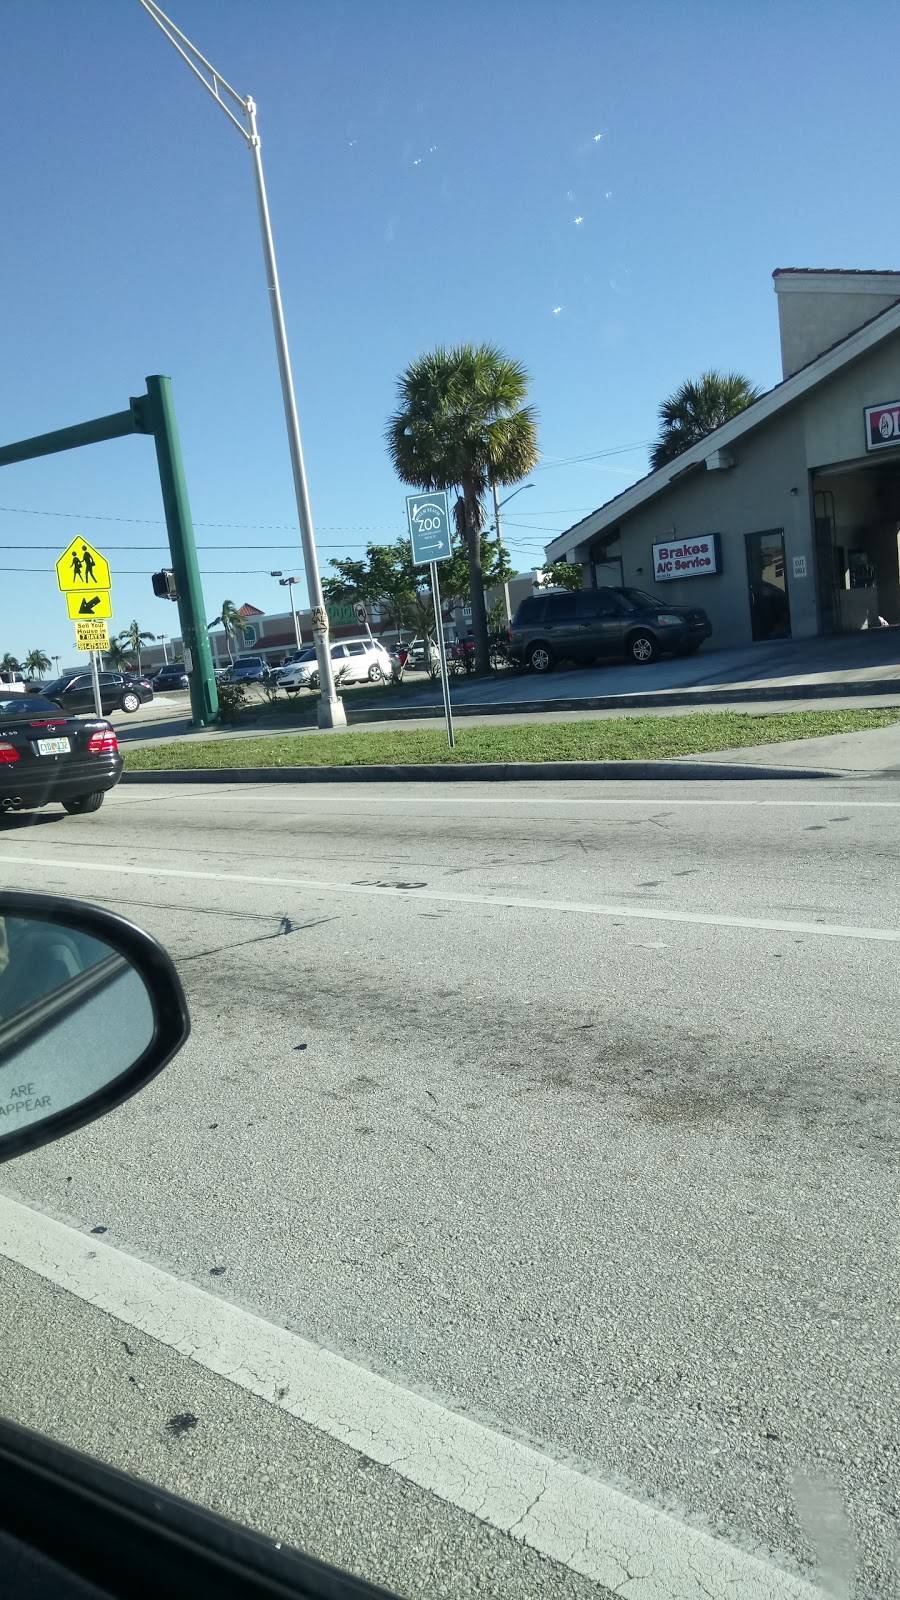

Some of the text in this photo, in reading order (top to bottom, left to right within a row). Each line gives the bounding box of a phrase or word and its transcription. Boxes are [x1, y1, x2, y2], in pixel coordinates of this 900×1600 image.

[418, 517, 441, 532] ZOO
[659, 543, 709, 560] Brakes
[657, 556, 711, 573] A/C Service
[9, 1082, 36, 1099] ARE
[0, 1095, 52, 1116] APPEAR
